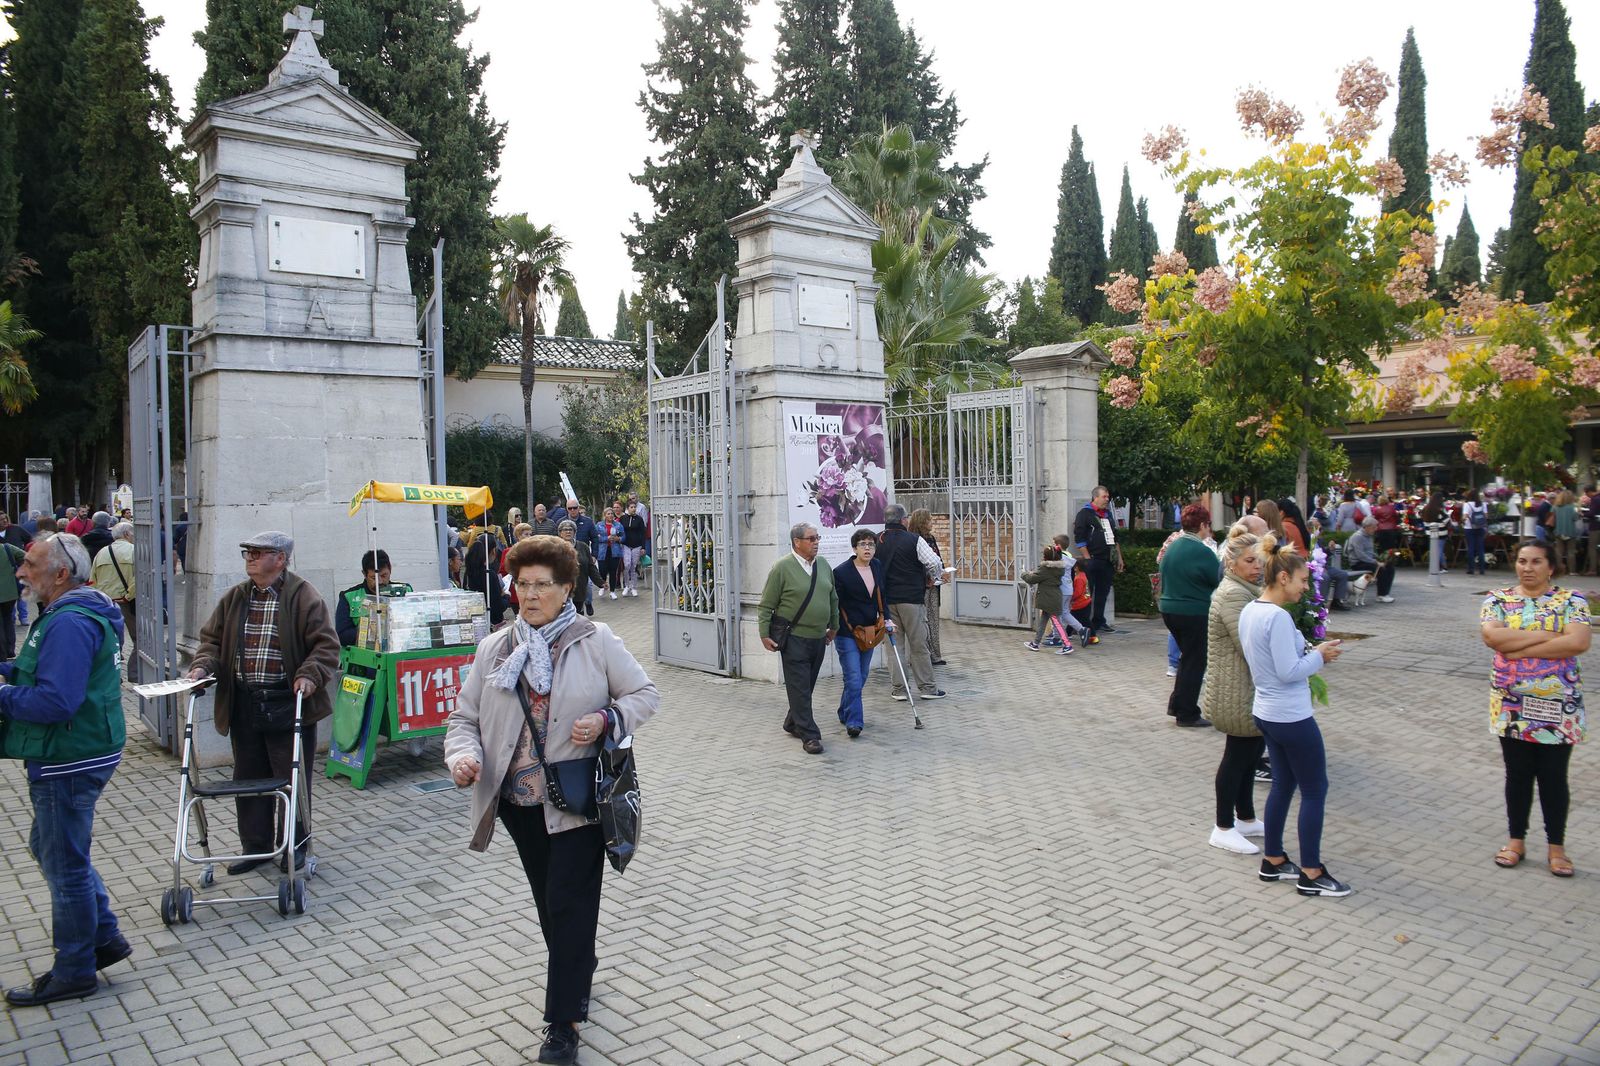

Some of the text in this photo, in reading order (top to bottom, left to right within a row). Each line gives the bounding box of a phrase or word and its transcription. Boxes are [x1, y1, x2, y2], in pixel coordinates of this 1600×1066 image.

[791, 415, 841, 434] Música
[423, 489, 465, 501] ONCE
[444, 686, 457, 699] ONCE
